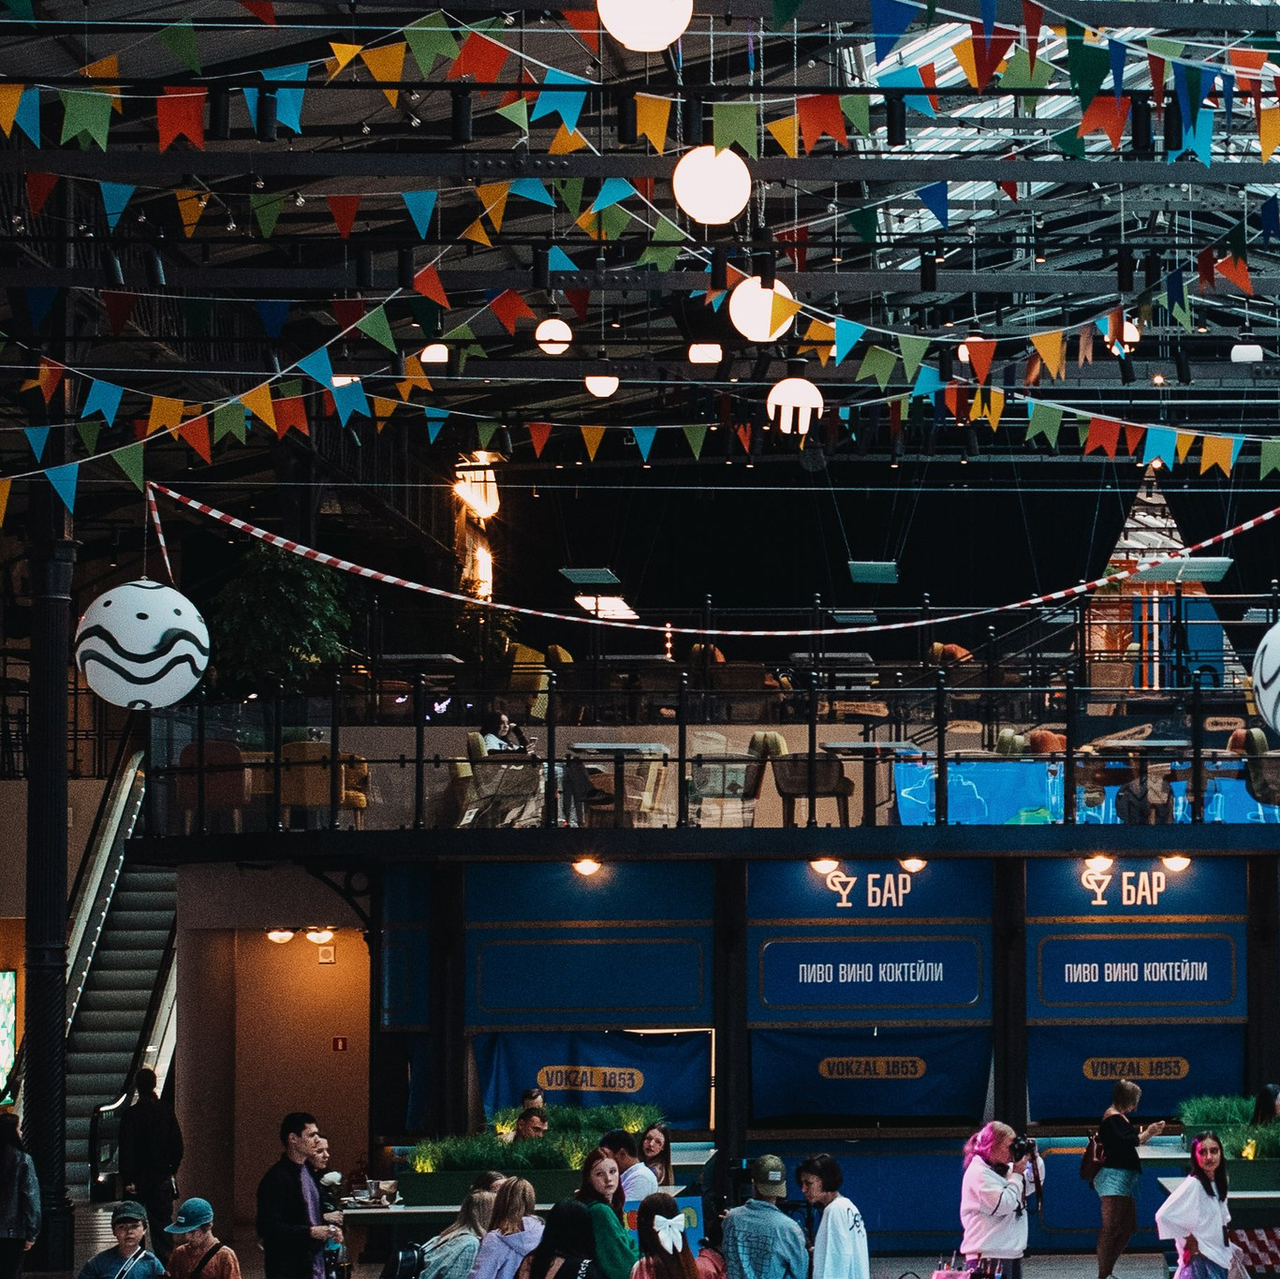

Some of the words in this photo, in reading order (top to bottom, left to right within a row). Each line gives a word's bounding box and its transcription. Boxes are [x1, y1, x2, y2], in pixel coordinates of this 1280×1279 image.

[867, 873, 912, 907] БАР
[1122, 871, 1166, 906] БАР
[798, 964, 833, 983] ПИВО
[838, 963, 873, 983] ВИНО
[878, 959, 944, 982] КОКТЕЙЛИ
[1064, 963, 1099, 983] ПИВО
[1104, 962, 1139, 982] ВИНО
[1143, 959, 1208, 982] КОКТЕЙЛИ
[545, 1069, 597, 1088] VOKZAL
[602, 1071, 635, 1089] 1853
[827, 1060, 880, 1076] VOKZAL
[885, 1060, 918, 1076] 1853
[1091, 1061, 1143, 1076] VOKZAL
[1149, 1060, 1181, 1076] 1853
